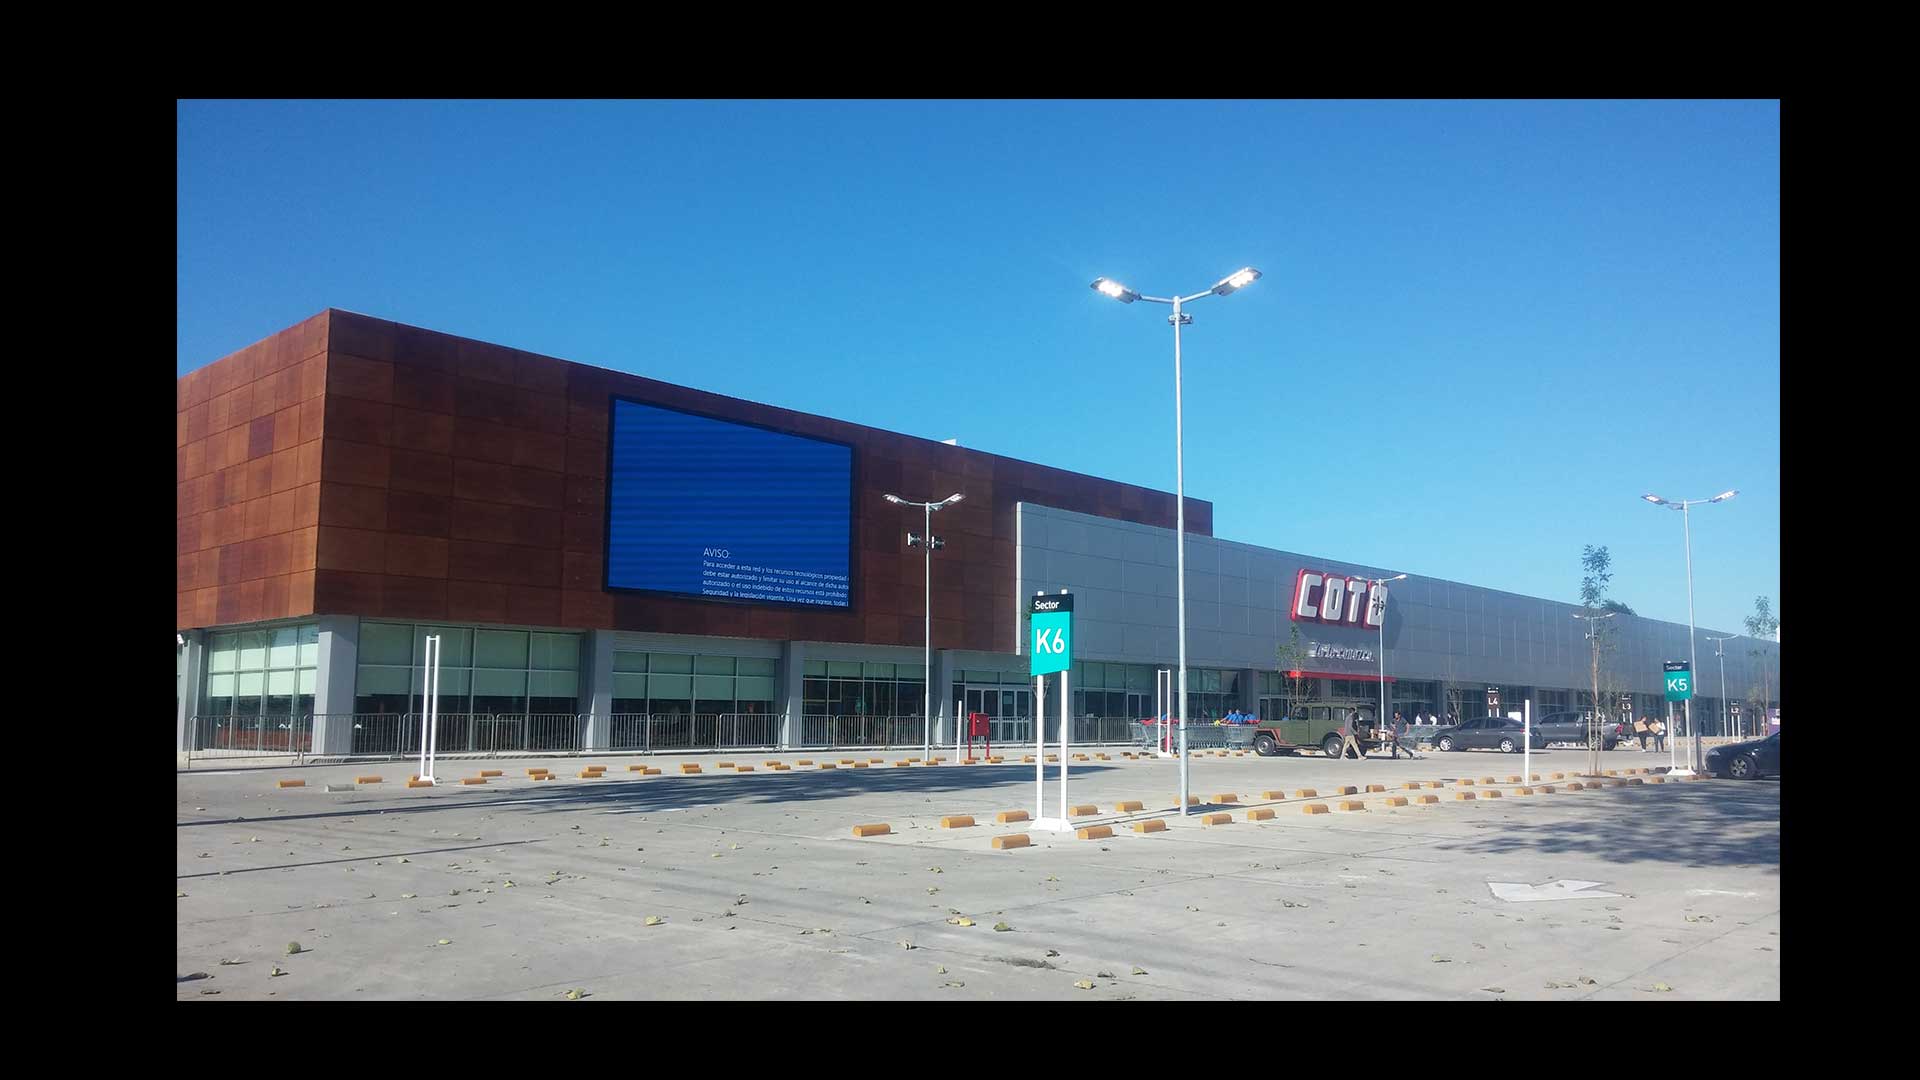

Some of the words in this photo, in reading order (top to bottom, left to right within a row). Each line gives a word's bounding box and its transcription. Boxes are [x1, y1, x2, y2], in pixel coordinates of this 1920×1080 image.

[703, 547, 731, 559] AVISO:
[703, 560, 715, 568] Para
[716, 562, 736, 570] acceder
[731, 573, 758, 581] autorizado
[703, 580, 730, 588] autorizado
[752, 583, 774, 592] indebido
[702, 588, 729, 597] Seguridad
[1034, 600, 1060, 610] Sector
[1296, 573, 1388, 626] COTO
[1036, 627, 1065, 654] K6
[1667, 678, 1688, 692] K5
[1487, 697, 1498, 705] L4
